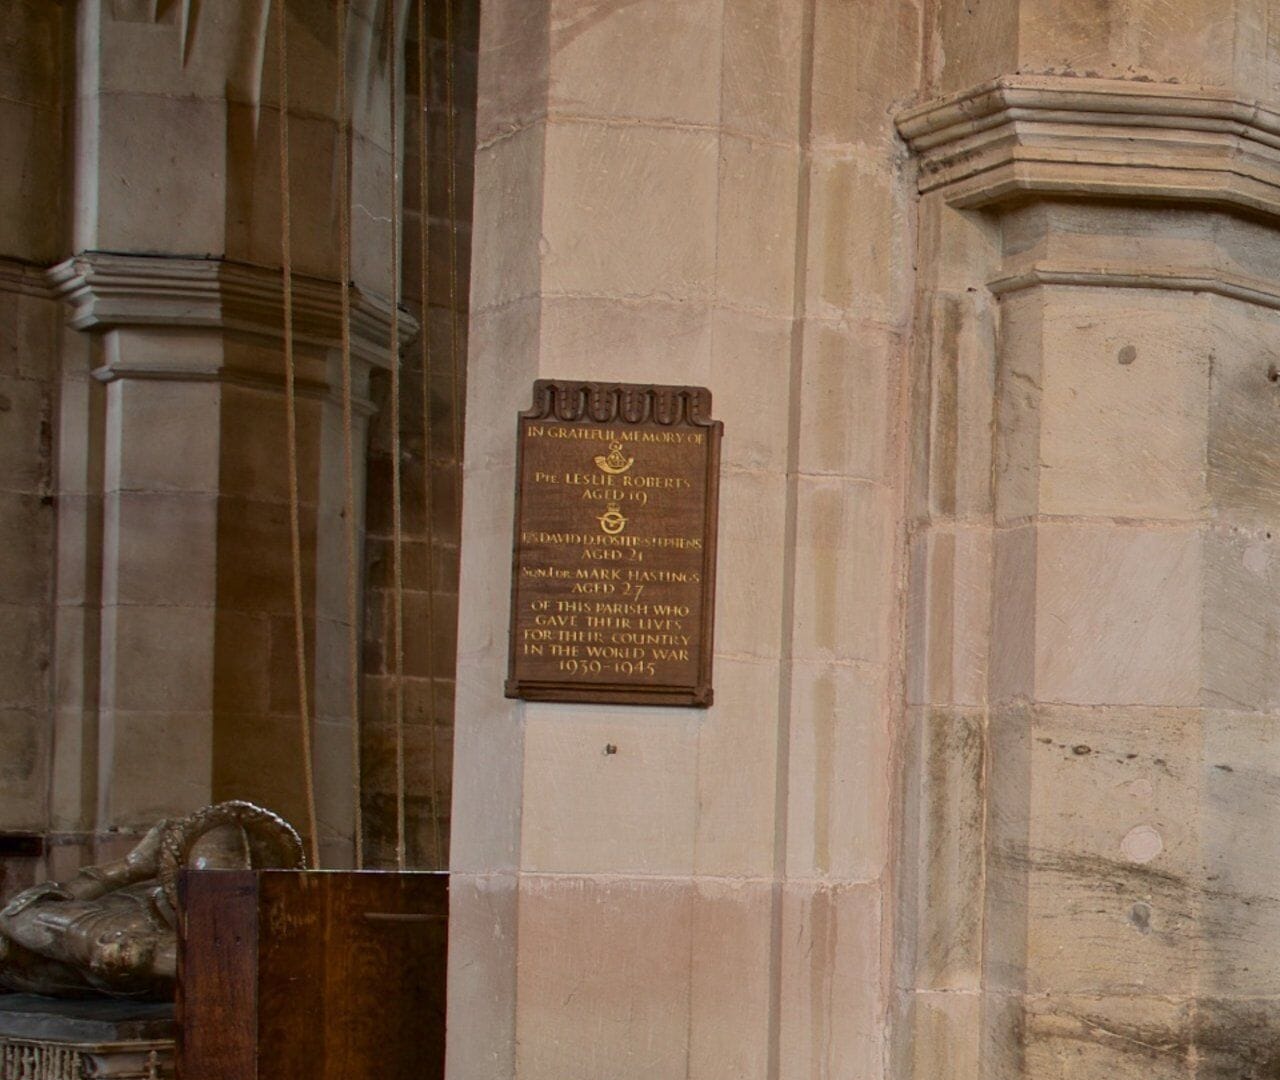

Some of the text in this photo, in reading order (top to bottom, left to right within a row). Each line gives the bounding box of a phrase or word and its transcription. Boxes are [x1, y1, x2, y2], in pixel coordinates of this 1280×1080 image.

[528, 426, 704, 444] IN GRATEFUL MEMORY OF
[566, 472, 614, 487] LESLIE
[623, 475, 691, 489] ROBERTS
[582, 489, 648, 506] AGED 19
[540, 532, 580, 544] DAVID
[581, 549, 643, 562] AGED 21
[576, 568, 621, 580] MARK
[628, 570, 700, 584] HASTINGS
[571, 582, 644, 602] AGED 27
[531, 600, 689, 617] OF THIS PARISH WHO
[536, 615, 682, 630] GAVE THEIR LIVES
[524, 629, 691, 646] FOR THEIR COUNTRY
[524, 644, 689, 661] IN THE WORLD WAR
[560, 659, 656, 676] 1939-1945
